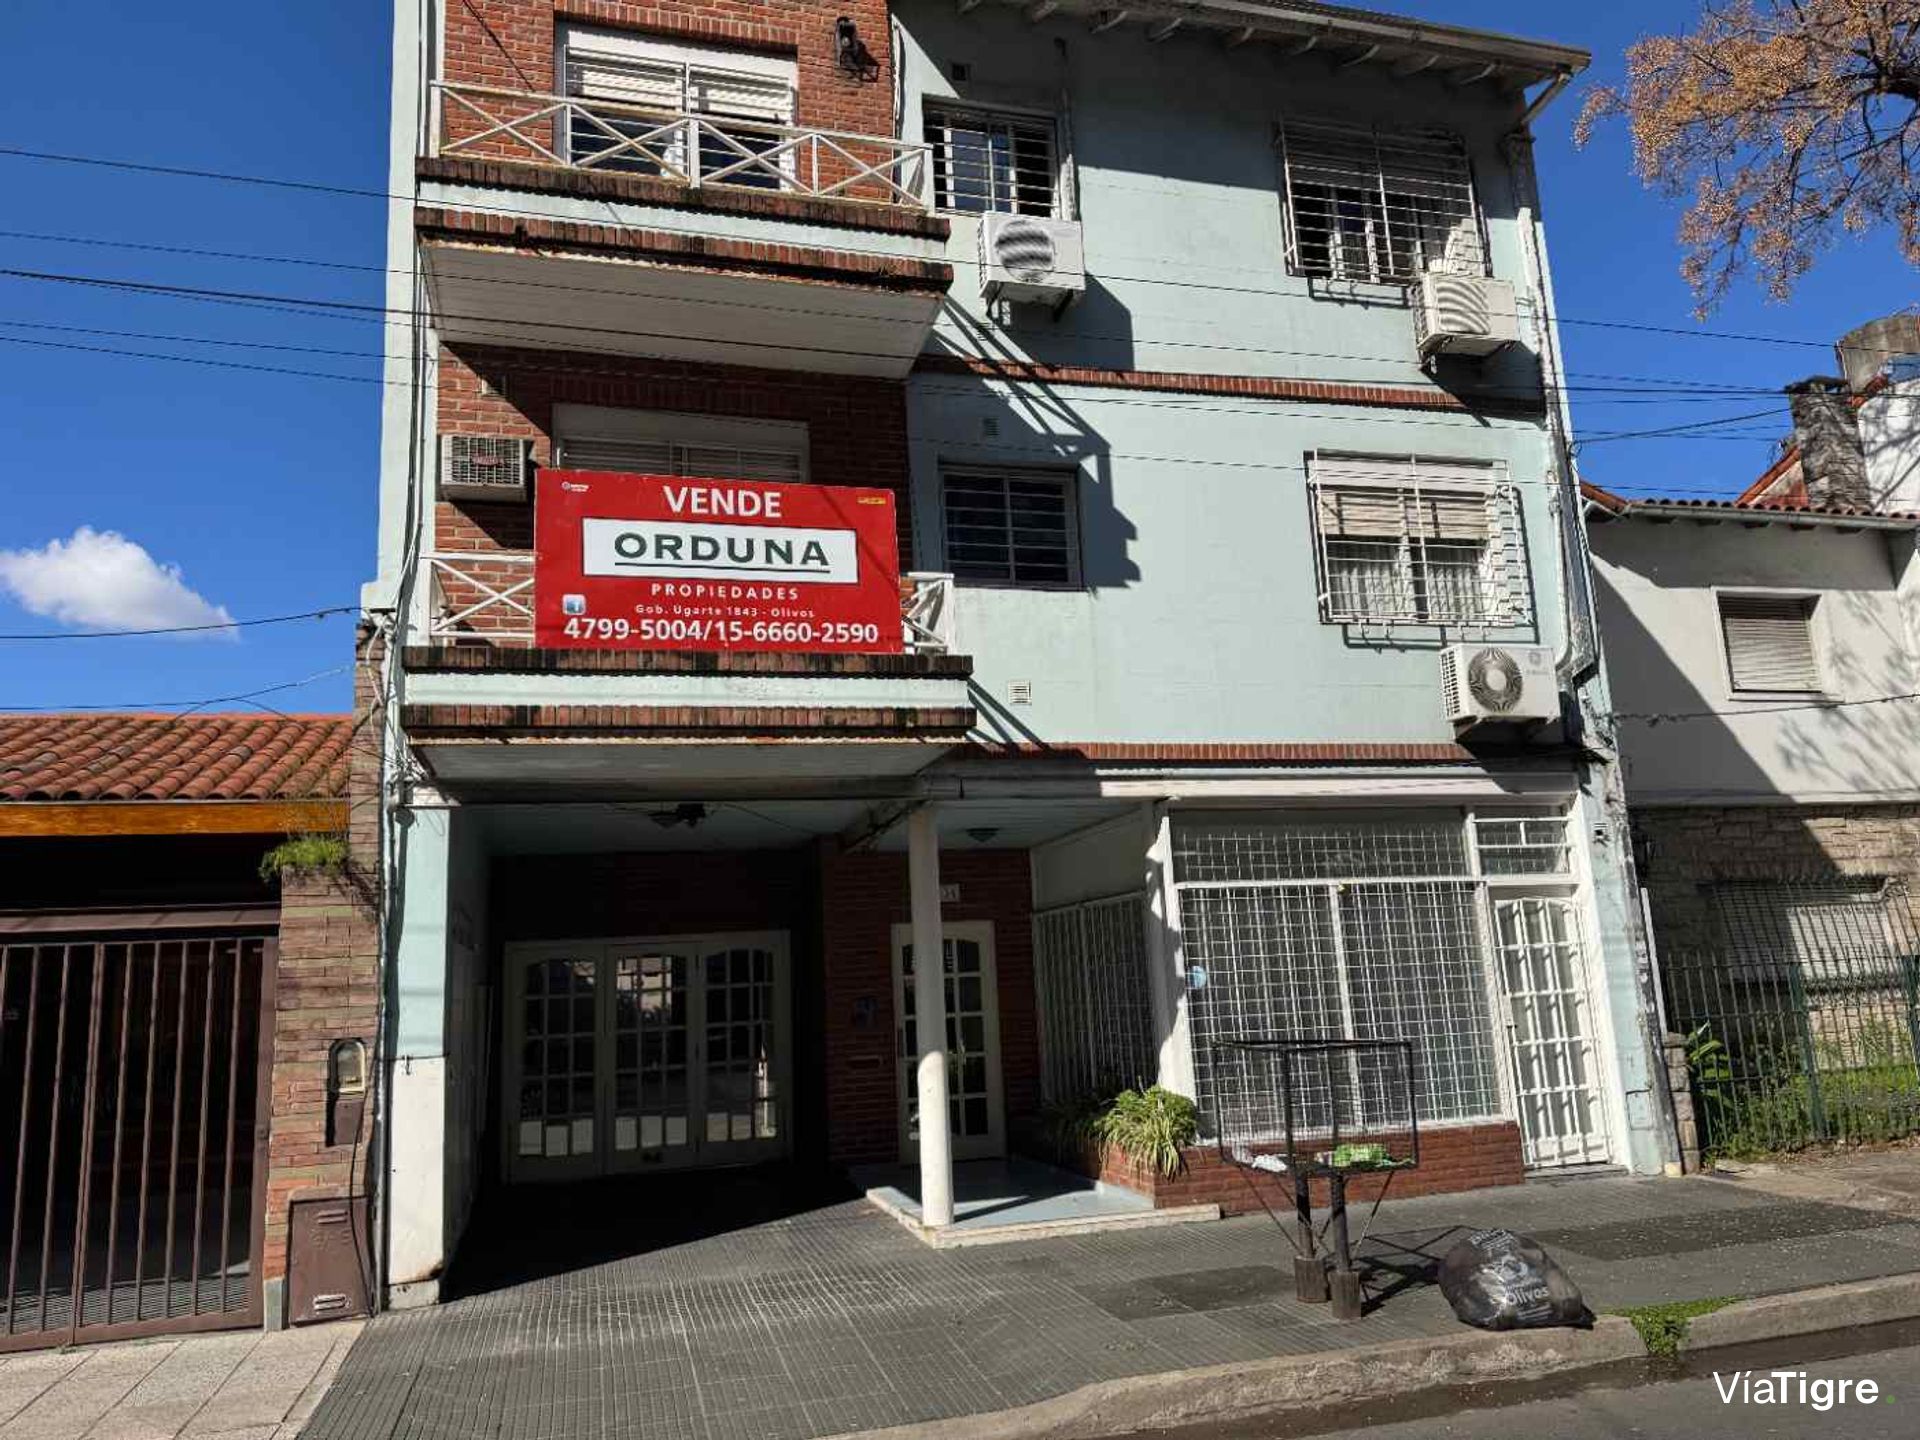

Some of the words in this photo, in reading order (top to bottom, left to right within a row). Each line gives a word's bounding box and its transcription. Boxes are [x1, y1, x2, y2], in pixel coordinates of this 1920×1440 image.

[662, 485, 781, 517] VENDE
[614, 532, 830, 566] ORDUNA
[651, 582, 799, 600] PROPIEDADES
[673, 605, 722, 617] Ugarte
[727, 606, 758, 617] 1843
[563, 618, 878, 643] 4799-5004/15-6660-2590
